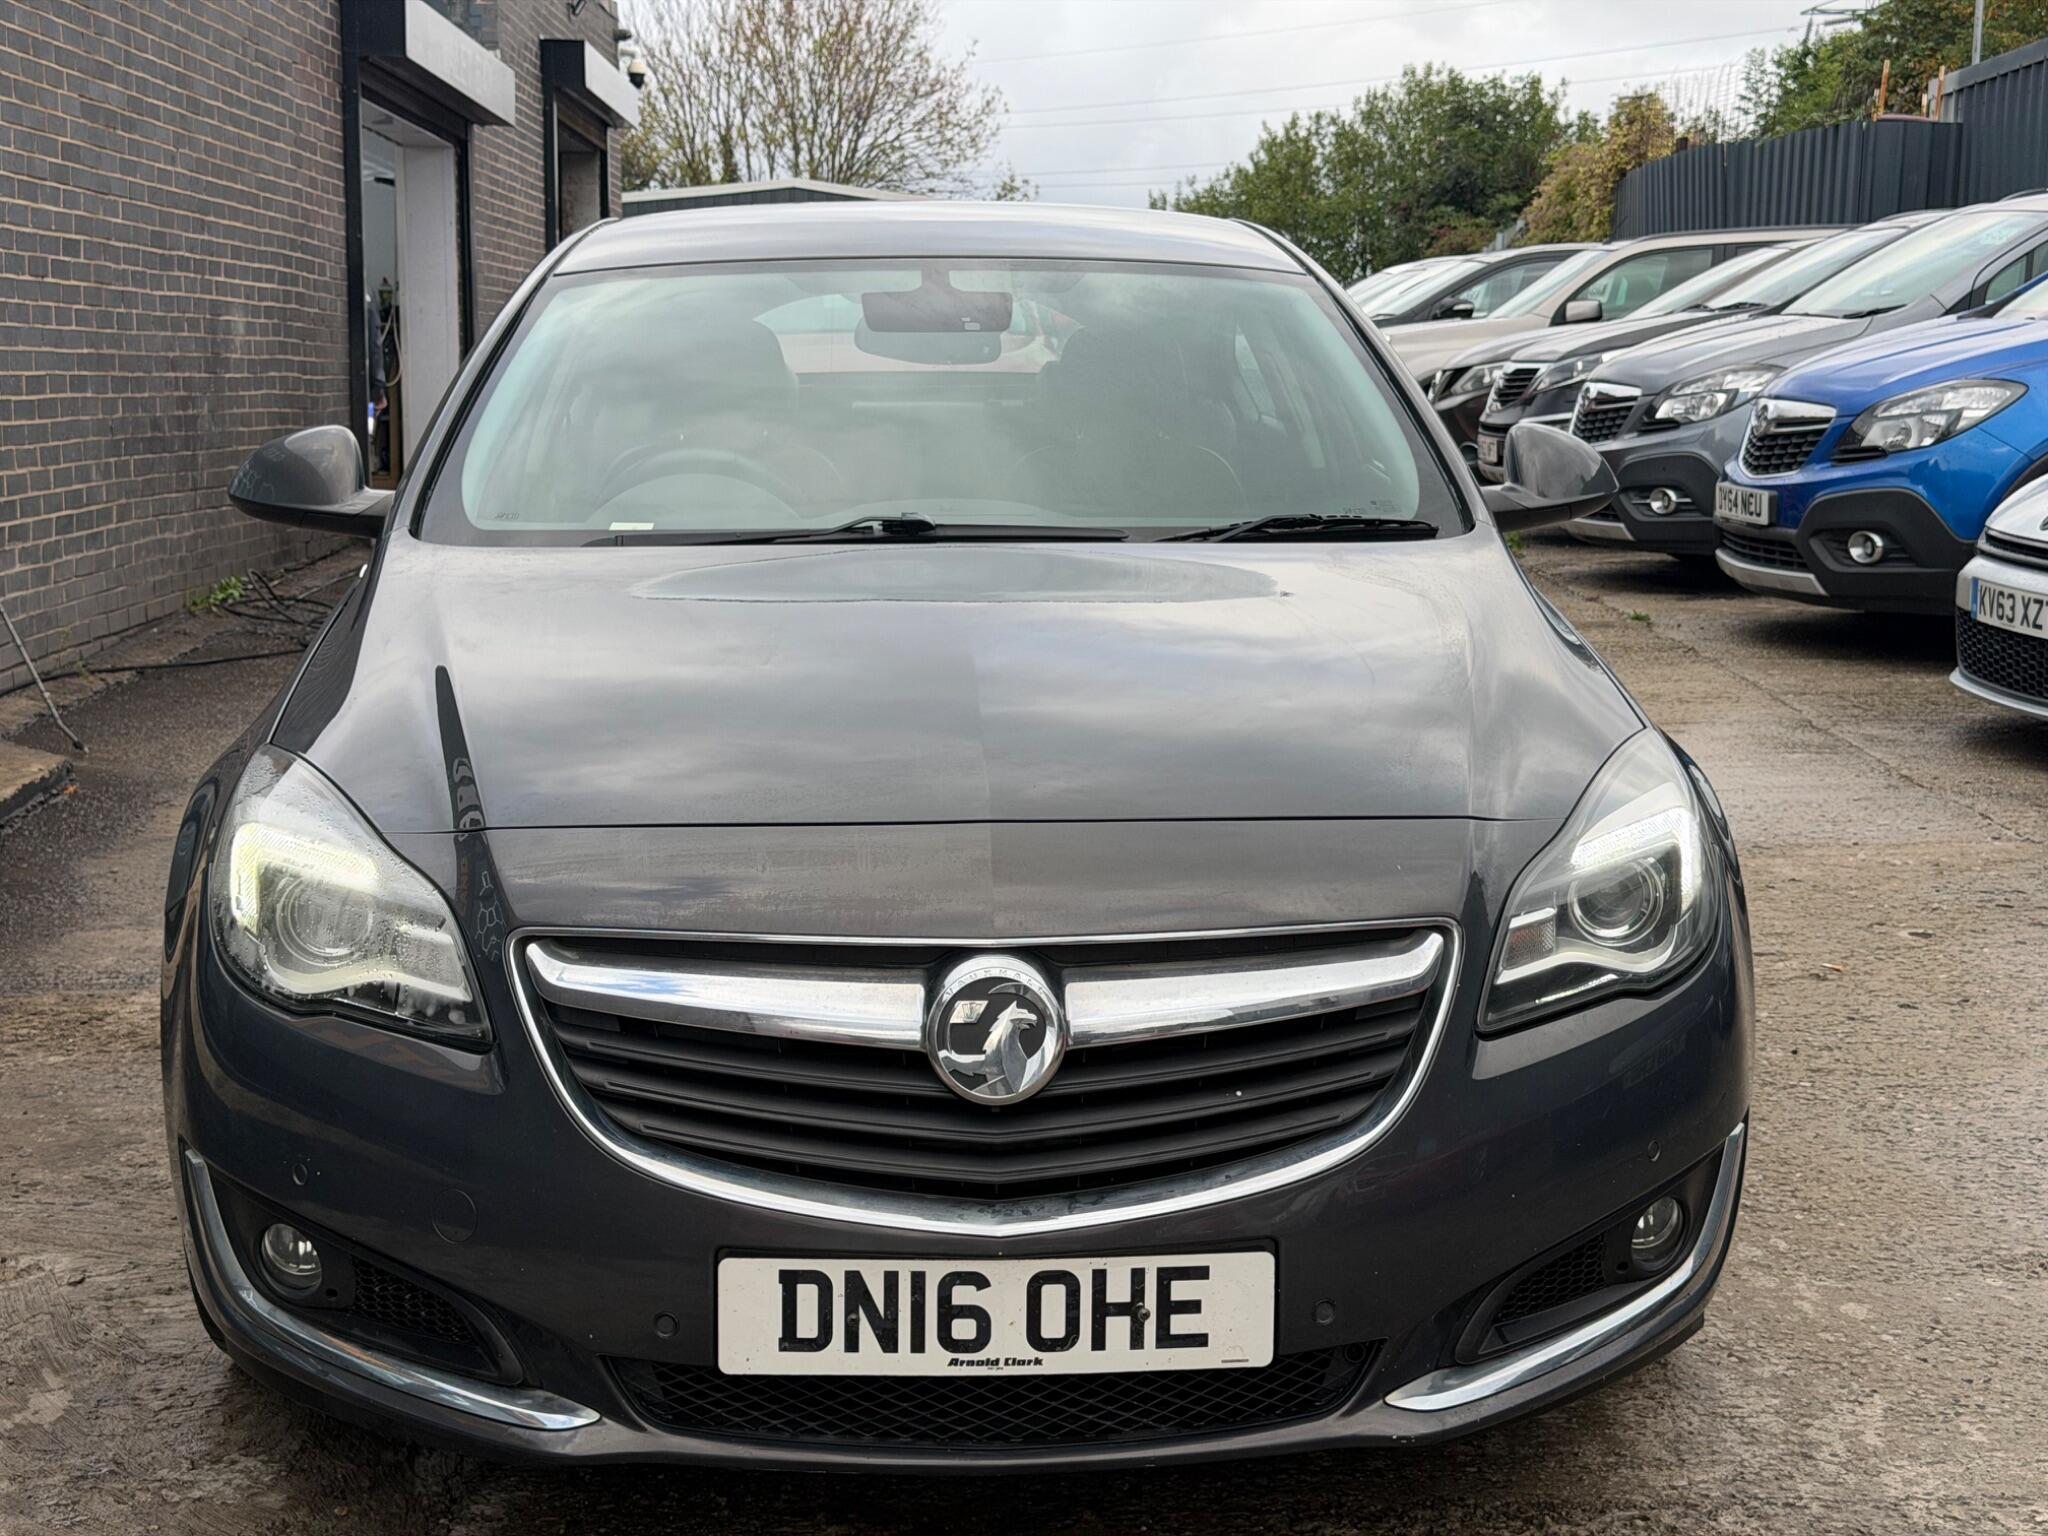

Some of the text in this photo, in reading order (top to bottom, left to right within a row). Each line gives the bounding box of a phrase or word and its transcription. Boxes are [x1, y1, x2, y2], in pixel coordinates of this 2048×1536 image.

[1740, 490, 1762, 517] NEU
[1979, 585, 2048, 631] KV63 XZ
[944, 968, 1045, 999] VAUXHALL
[778, 1265, 1210, 1354] DN16 OHE
[947, 1356, 1044, 1367] Arnold Clark
